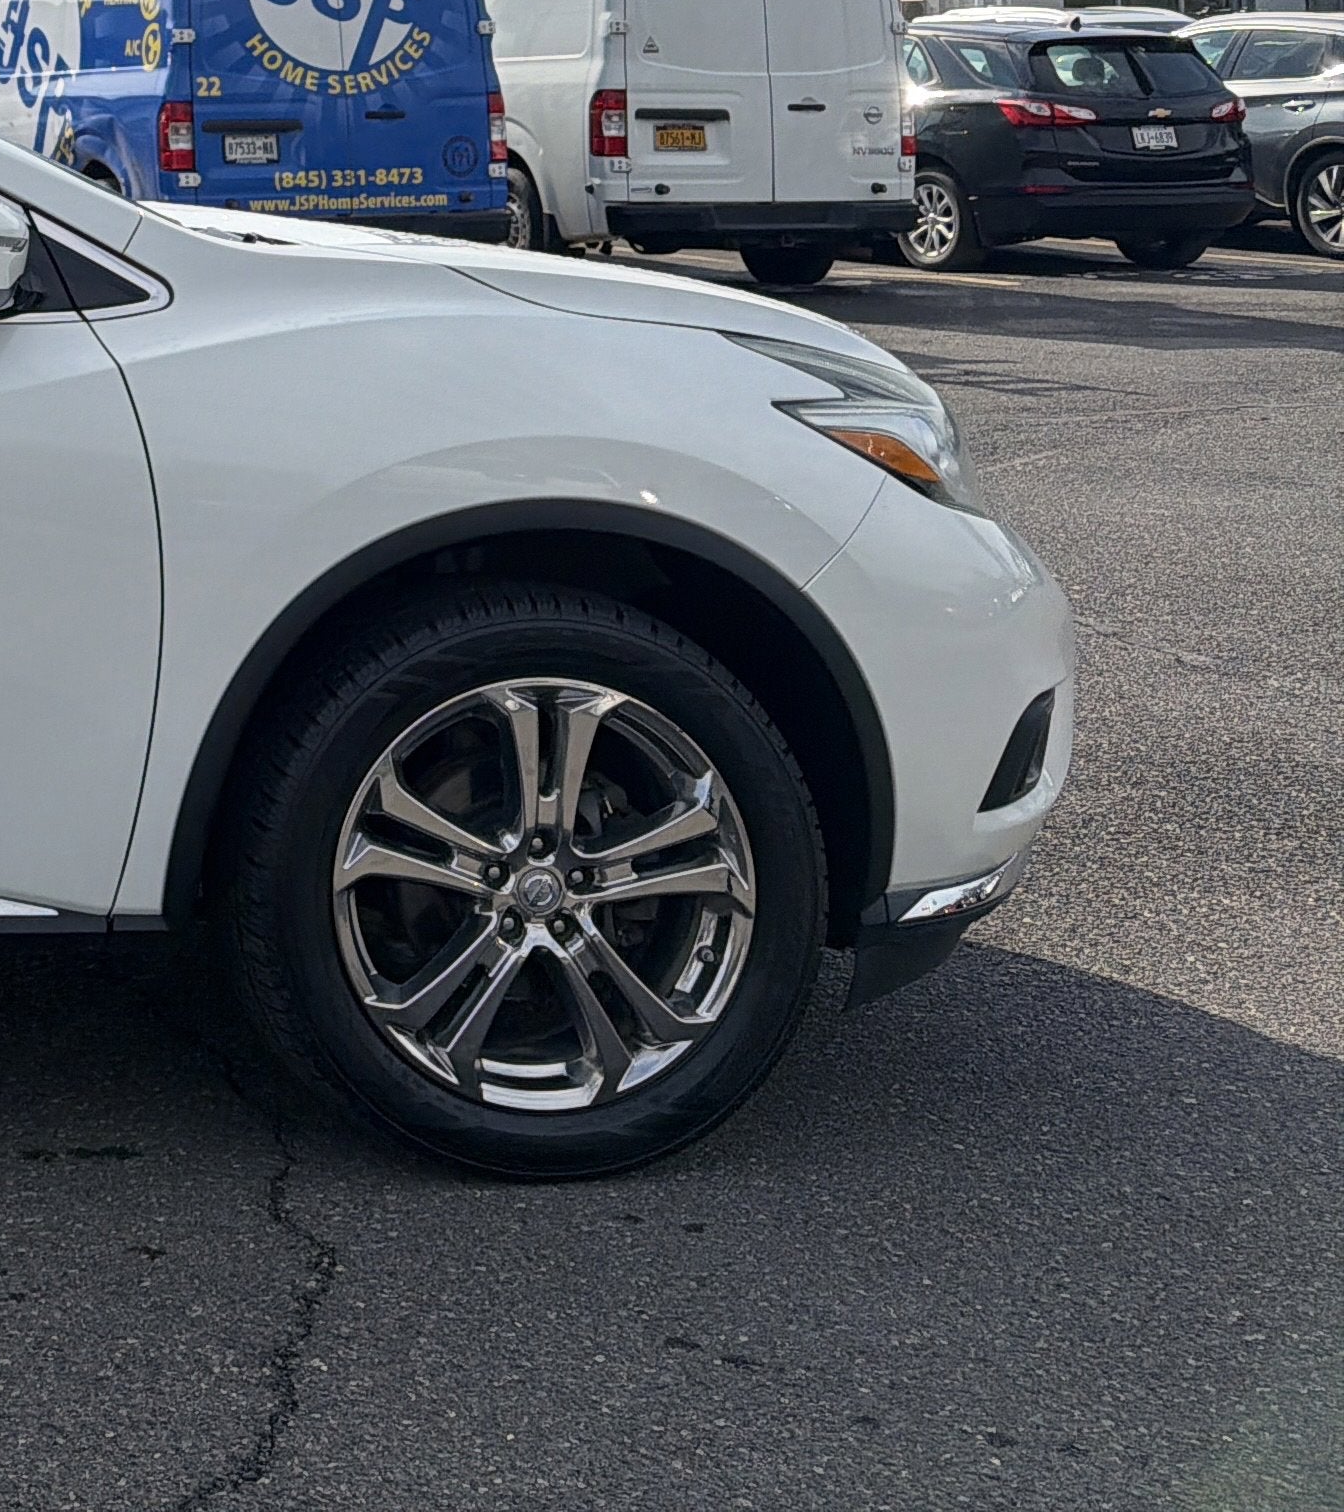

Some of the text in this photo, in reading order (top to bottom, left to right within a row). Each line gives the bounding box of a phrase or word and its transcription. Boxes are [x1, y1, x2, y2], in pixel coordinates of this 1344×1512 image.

[124, 39, 141, 57] A/C
[245, 26, 432, 96] HOME SERVICES
[196, 76, 222, 97] 22
[274, 167, 423, 191] (845) 331-8473
[248, 192, 448, 212] www.JSPHomeServices.com
